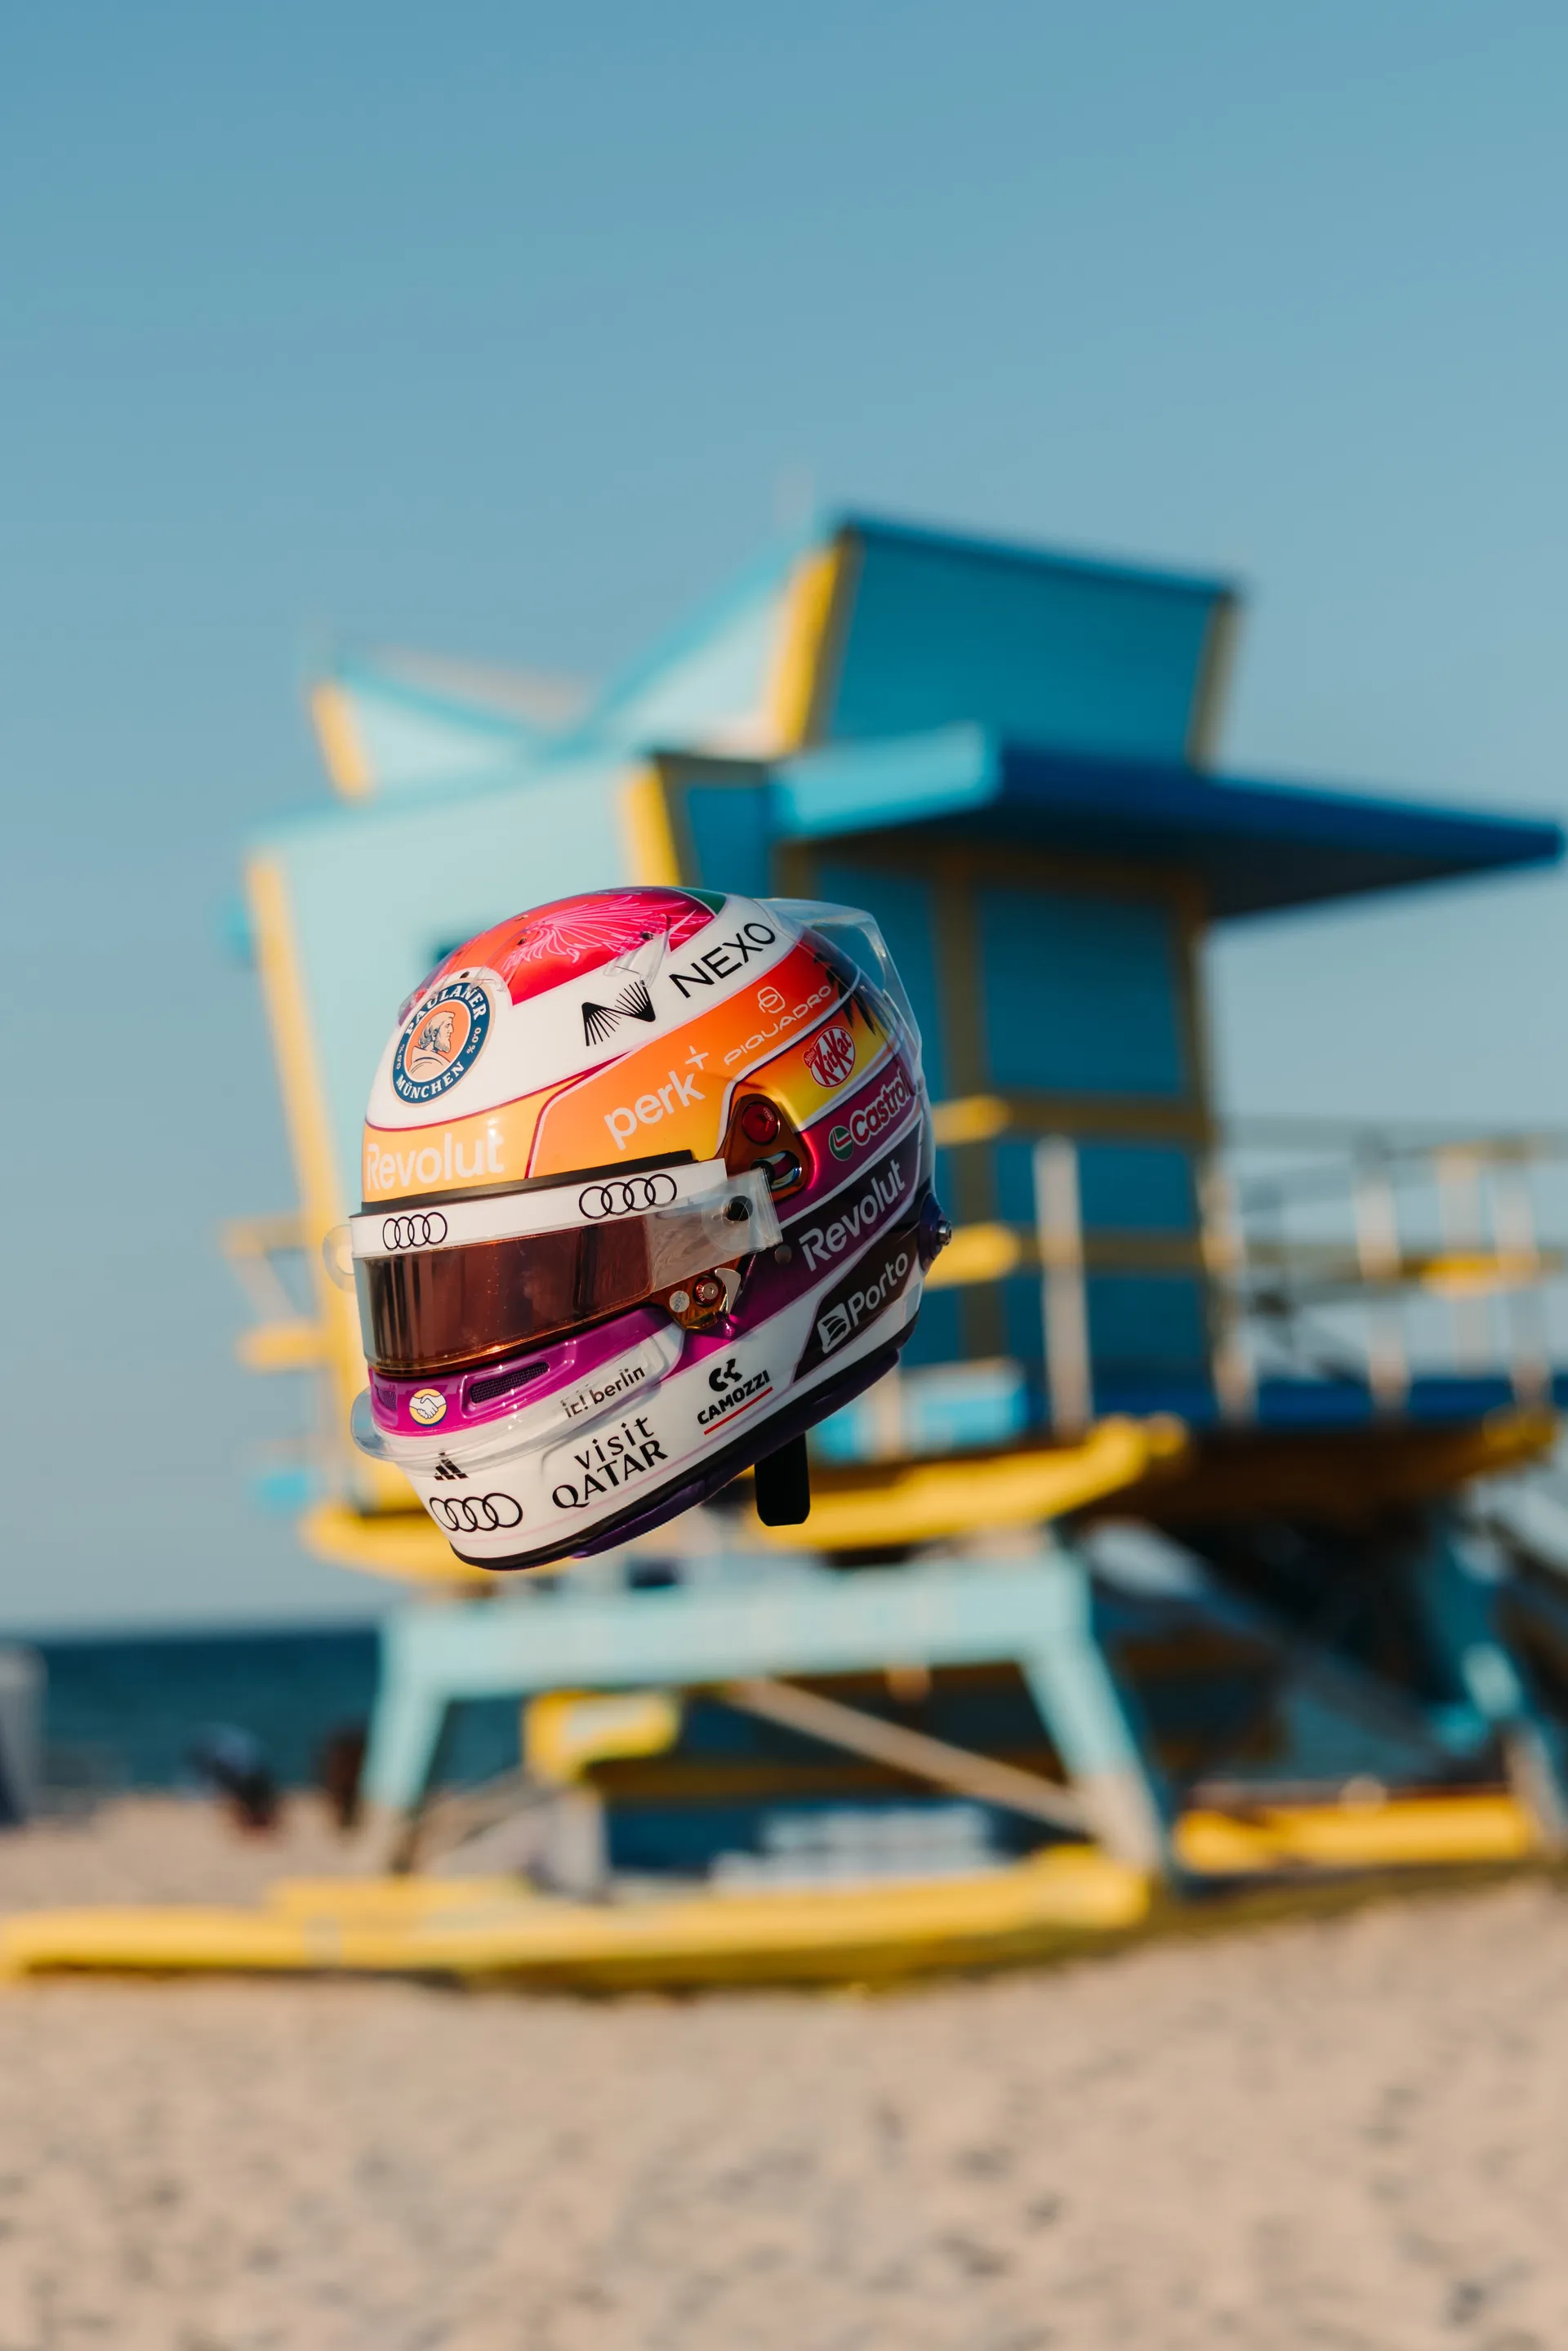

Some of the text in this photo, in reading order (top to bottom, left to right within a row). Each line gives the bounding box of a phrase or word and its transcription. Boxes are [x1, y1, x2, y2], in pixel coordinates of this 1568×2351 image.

[669, 923, 775, 999] NEXO
[406, 985, 487, 1035] PAULANER
[724, 985, 831, 1065] PIQUADRO
[396, 1062, 464, 1098] MÜNCHEN
[850, 1069, 911, 1146] Castrol
[368, 1132, 504, 1191] Revolut
[799, 1160, 905, 1271] Revolut
[848, 1253, 908, 1327] Porto
[589, 1367, 645, 1405] berlin
[697, 1369, 770, 1424] CAMOZZI
[552, 1440, 668, 1508] QATAR
[574, 1417, 654, 1470] visit
